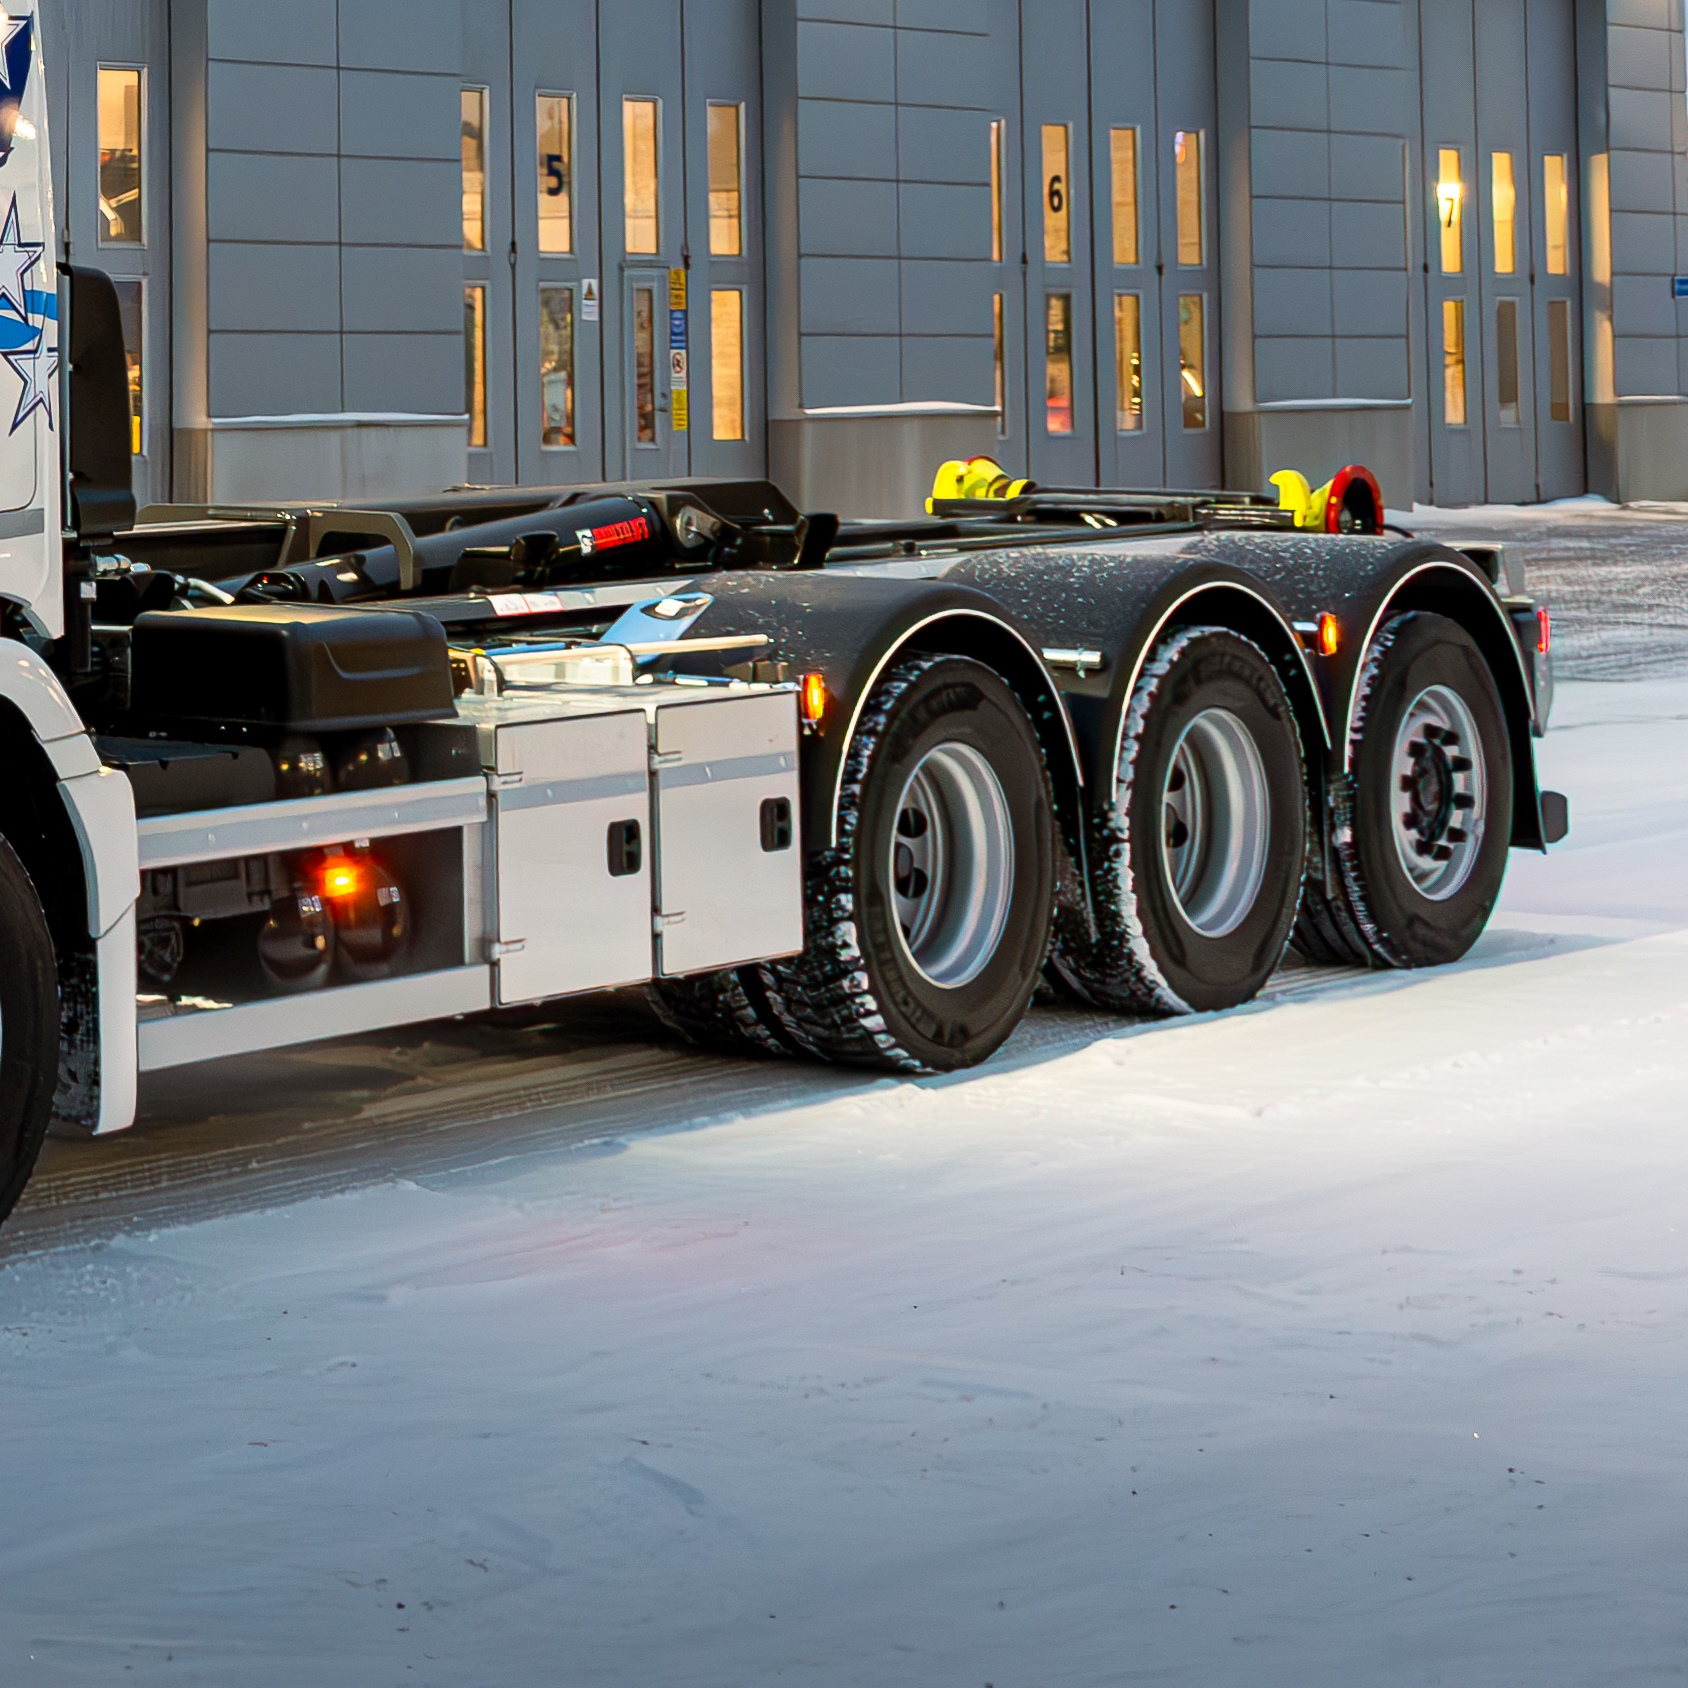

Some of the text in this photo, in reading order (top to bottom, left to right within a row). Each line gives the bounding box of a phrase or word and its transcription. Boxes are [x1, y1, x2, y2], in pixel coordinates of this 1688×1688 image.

[546, 153, 564, 197] 5
[1048, 174, 1064, 214] 6
[1444, 197, 1455, 229] 7
